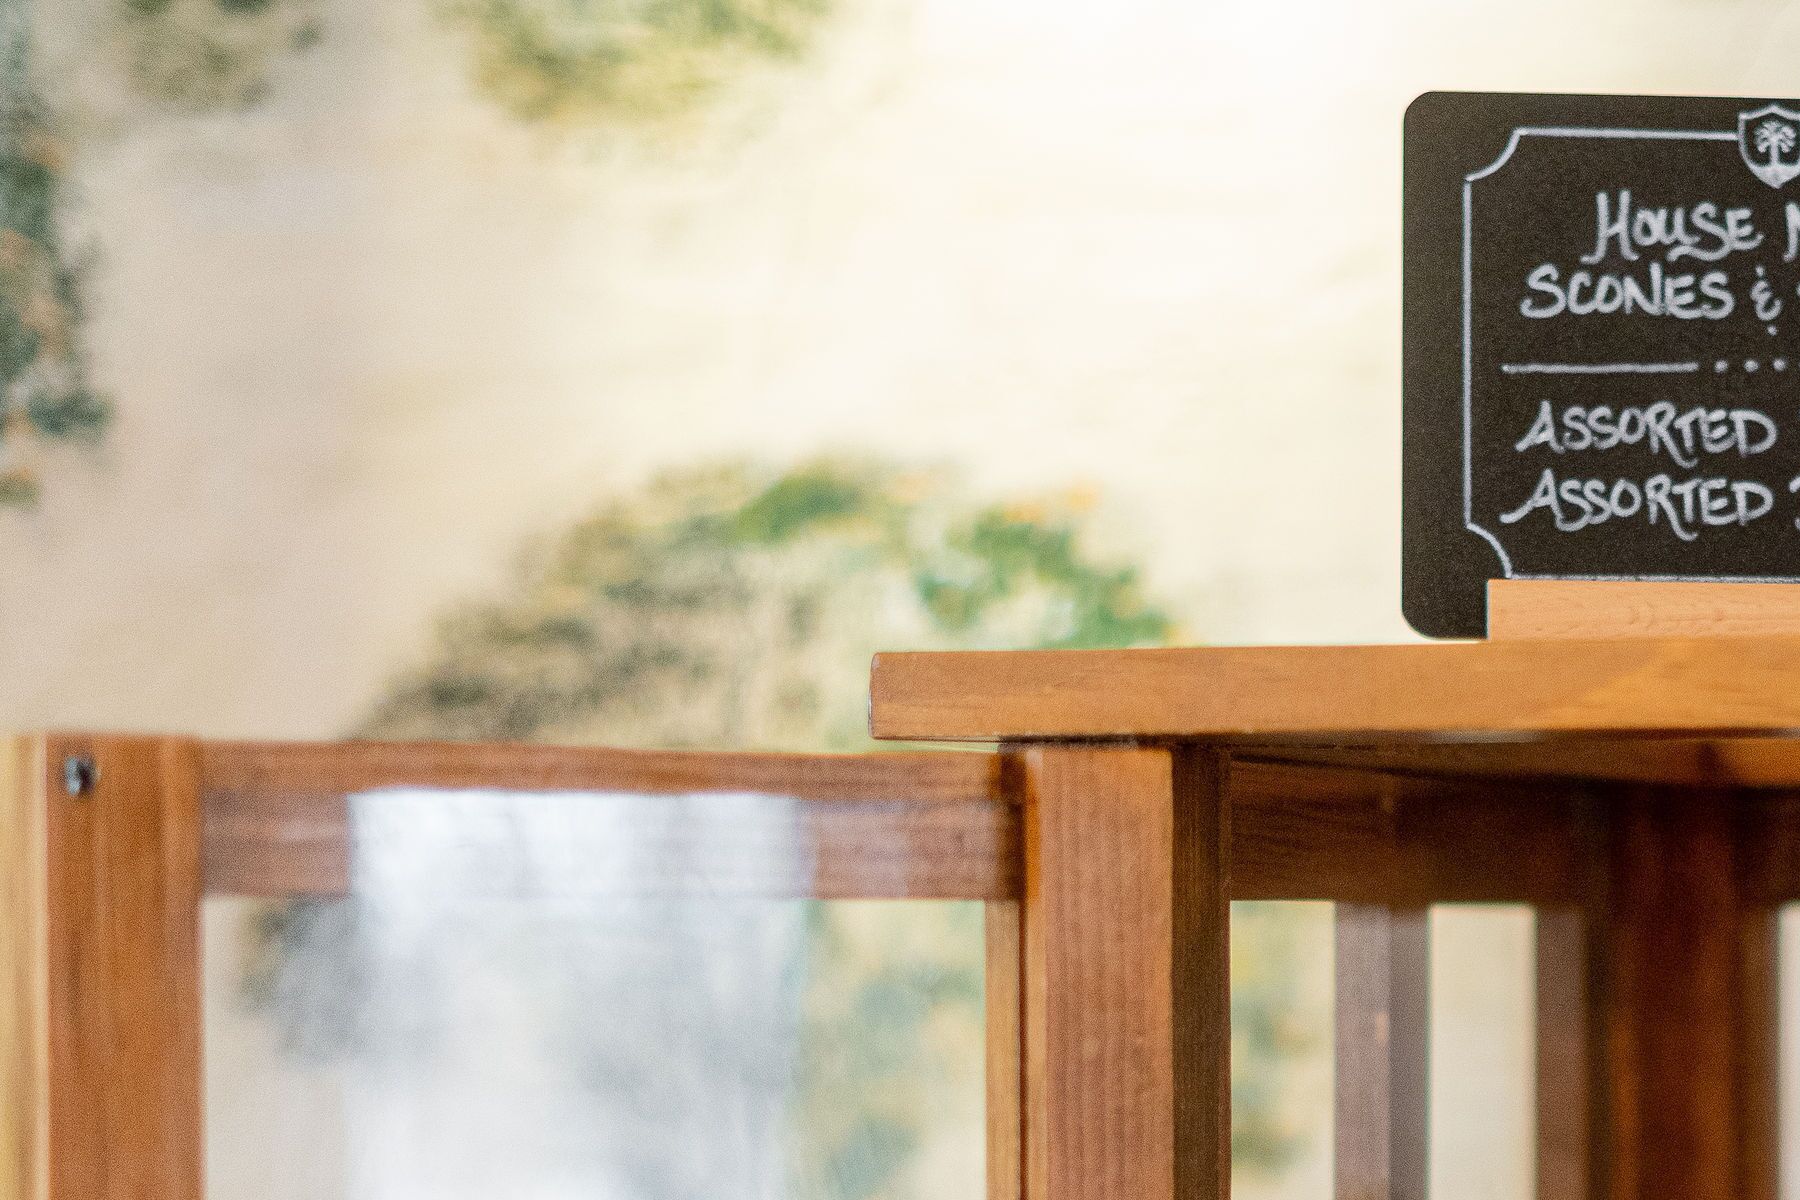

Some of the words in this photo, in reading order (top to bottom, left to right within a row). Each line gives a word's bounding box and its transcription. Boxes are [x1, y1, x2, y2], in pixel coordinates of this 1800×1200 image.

[1519, 261, 1736, 321] SCONES
[1514, 399, 1778, 470] ASSORTED
[1498, 467, 1775, 543] ASSORTED
